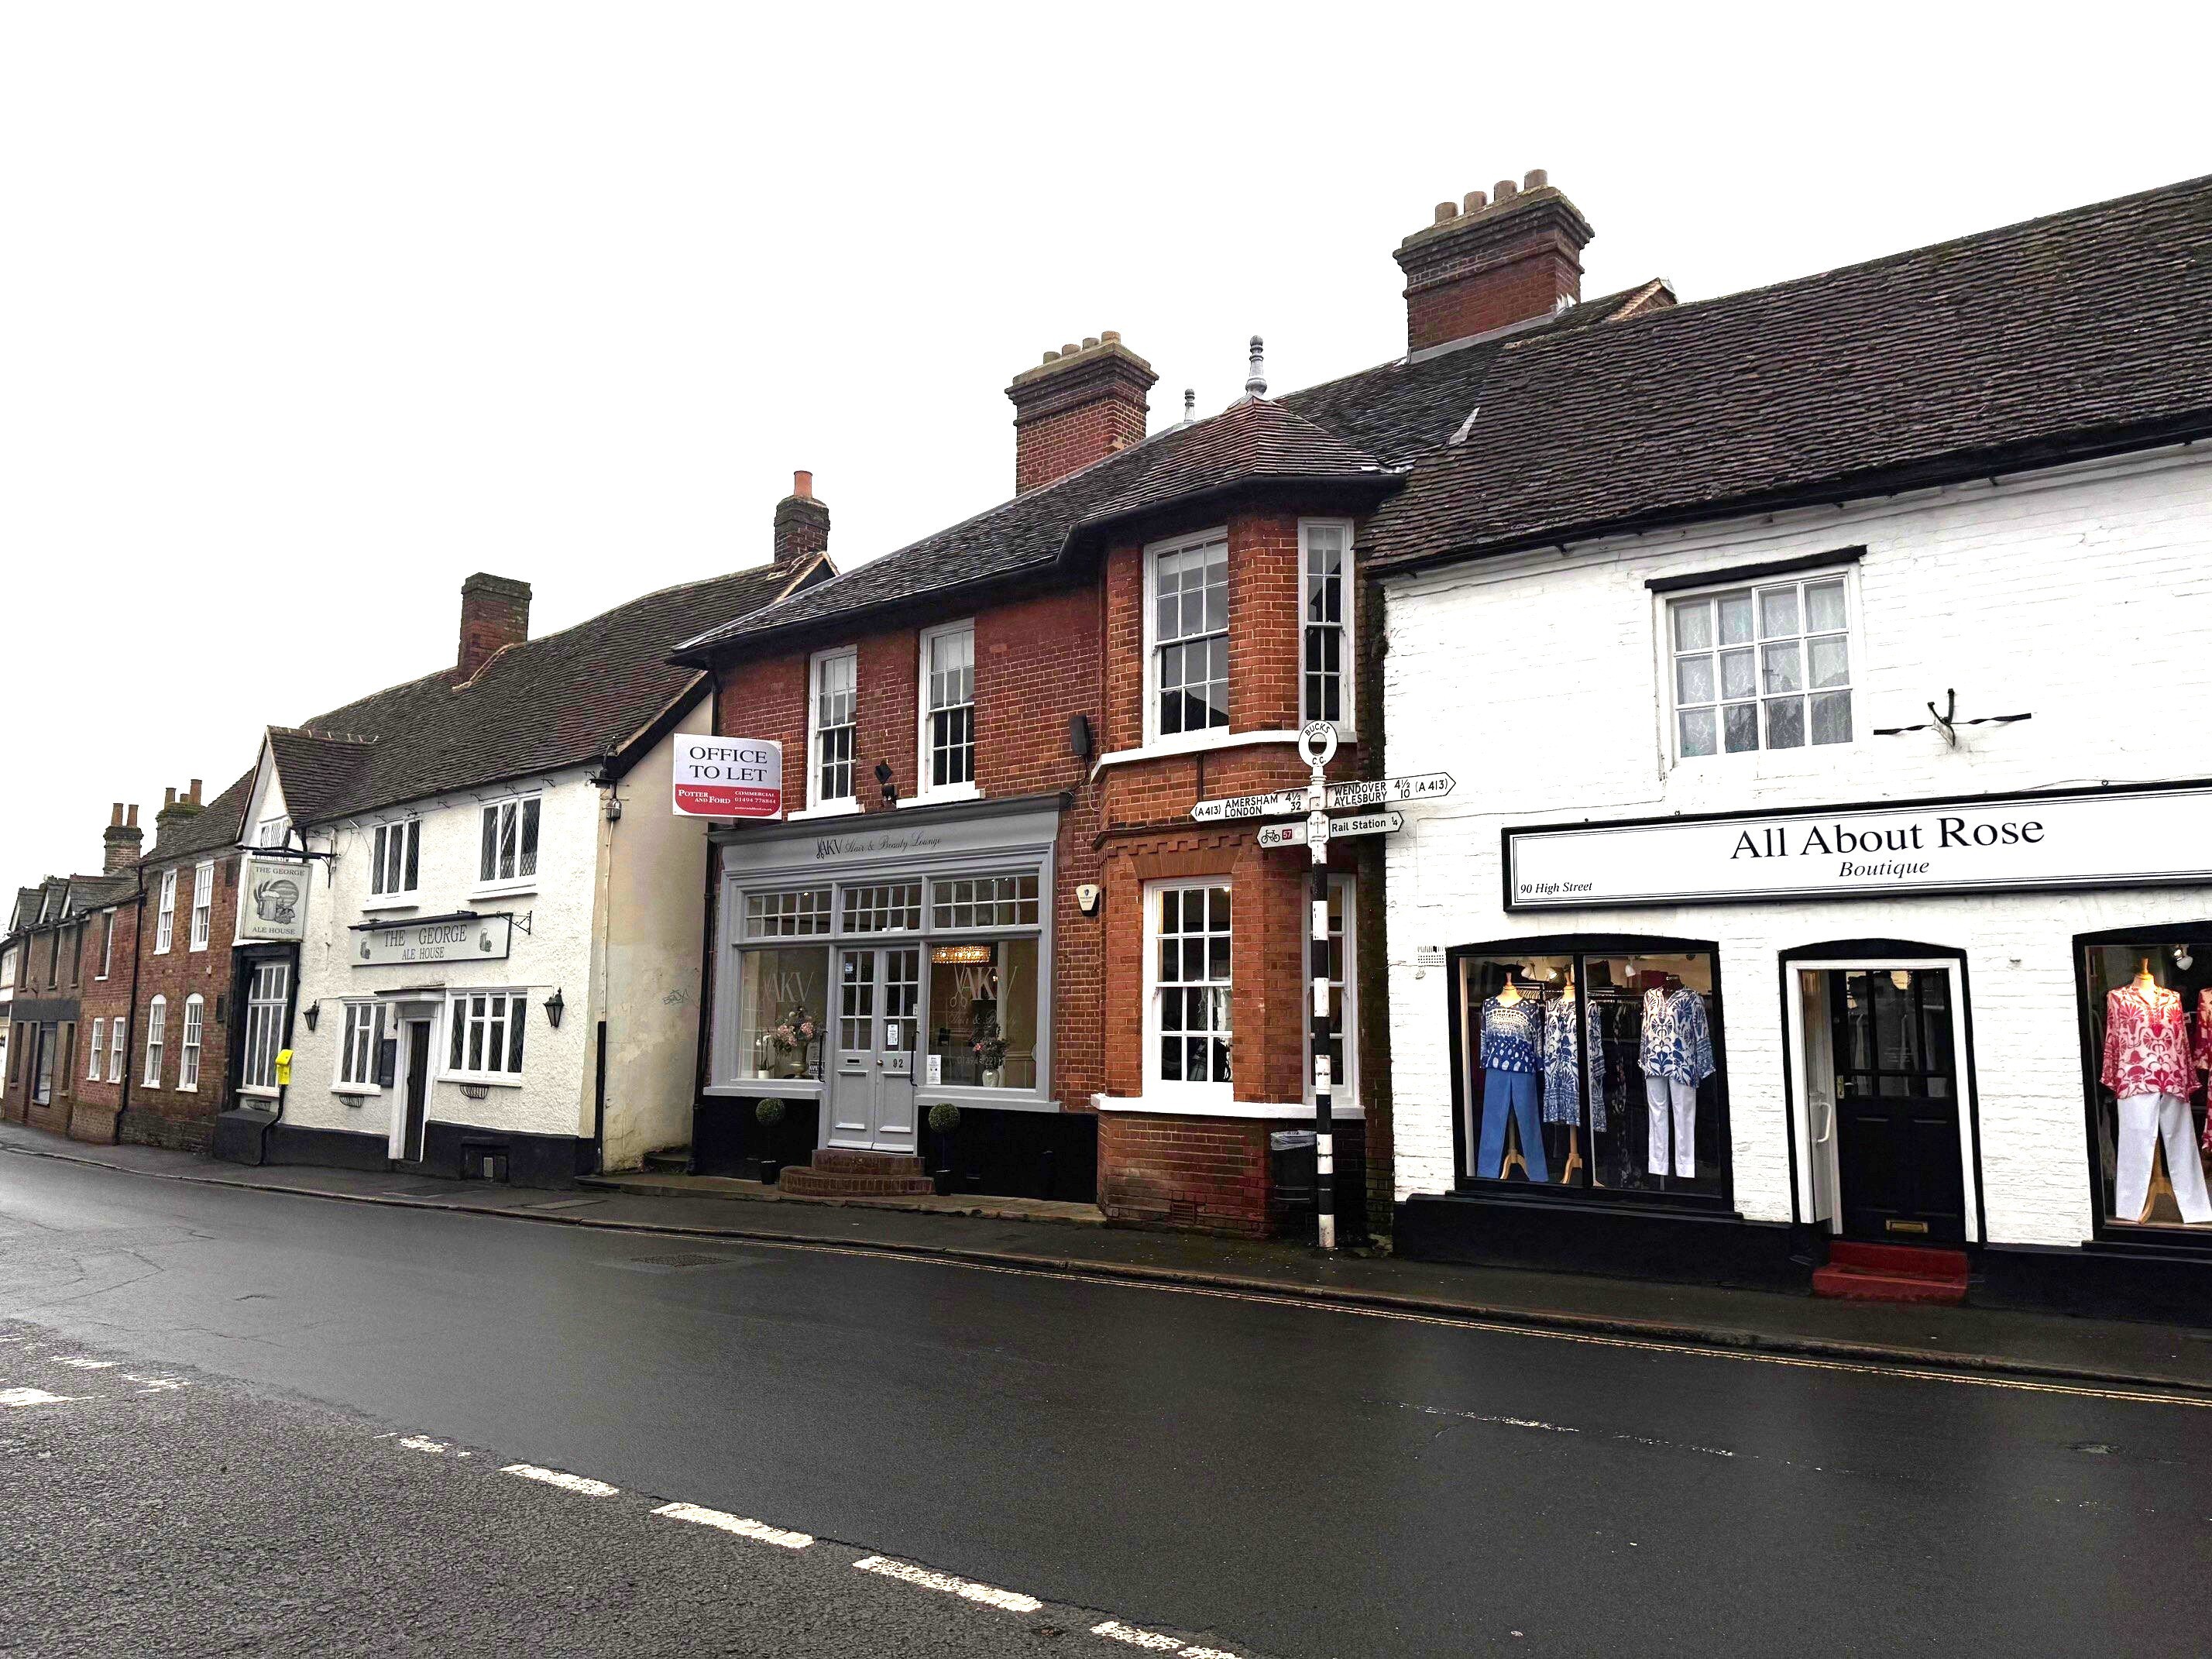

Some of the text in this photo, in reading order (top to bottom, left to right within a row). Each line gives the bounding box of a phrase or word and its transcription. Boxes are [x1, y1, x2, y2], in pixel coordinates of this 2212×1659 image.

[1305, 723, 1330, 736] BUCKS
[689, 747, 768, 764] OFFICE
[689, 765, 768, 781] TO LET
[1334, 781, 1386, 796] WENDOVER
[1225, 794, 1278, 809] AMERSHAM
[1334, 789, 1410, 807] AYLESBURY 10
[1224, 802, 1301, 818] LONDON 32
[1331, 823, 1349, 833] Rail
[1352, 819, 1386, 830] Station
[867, 840, 874, 851] &
[910, 830, 941, 847] Lounge
[1729, 817, 2045, 860] All About Rose
[273, 867, 305, 876] GEORGE
[1838, 859, 1930, 878] Boutique
[1520, 881, 1592, 895] 90 High Street
[383, 924, 468, 947] THE GEORGE
[402, 946, 445, 960] ALE HOUSE
[893, 1059, 903, 1068] 92
